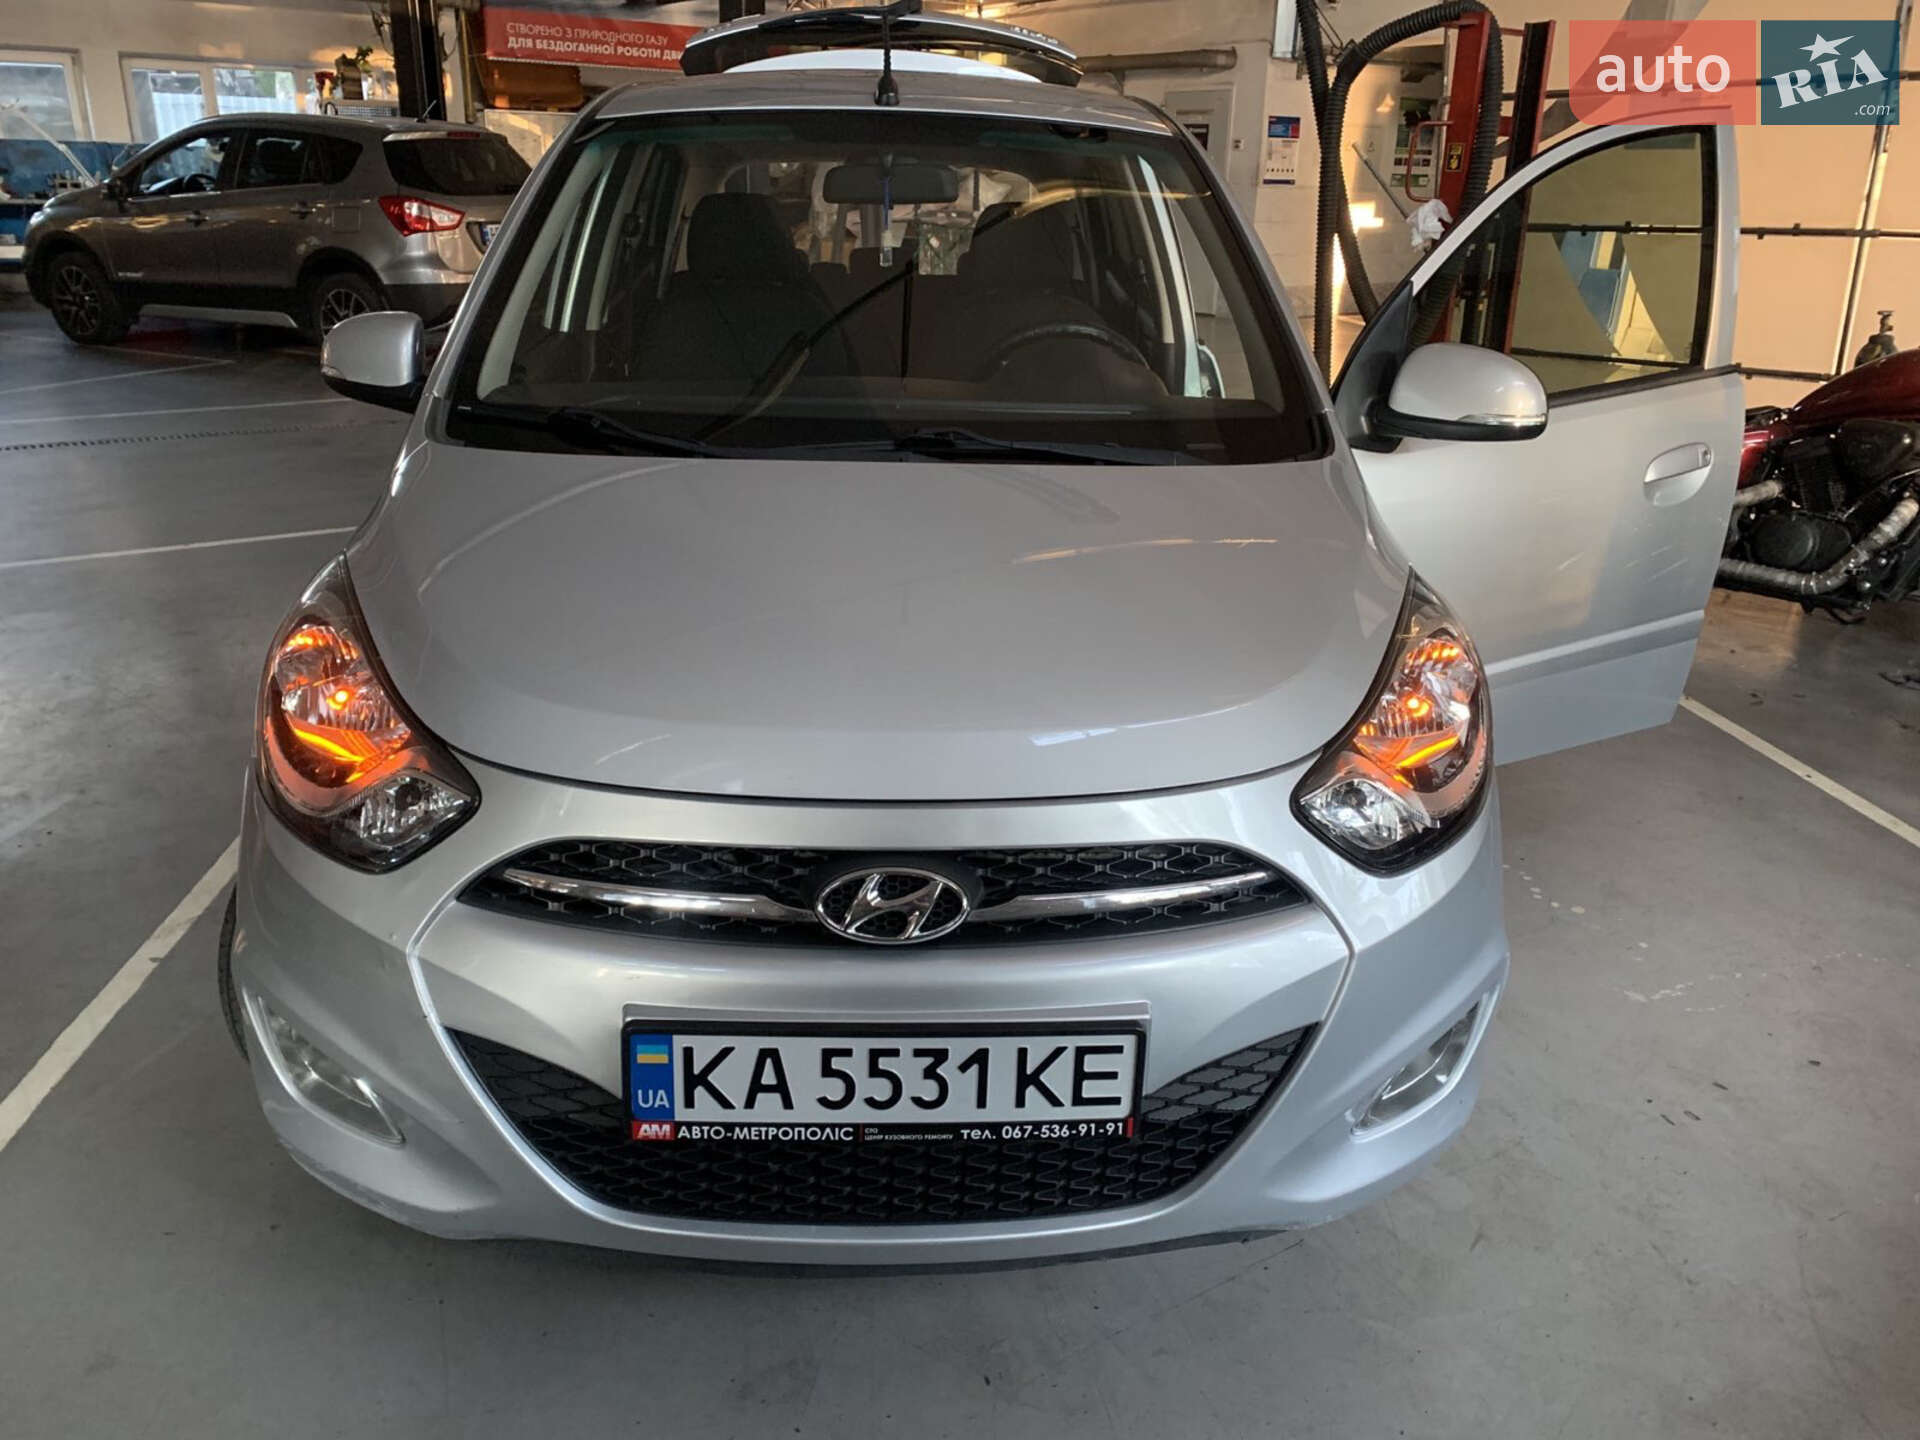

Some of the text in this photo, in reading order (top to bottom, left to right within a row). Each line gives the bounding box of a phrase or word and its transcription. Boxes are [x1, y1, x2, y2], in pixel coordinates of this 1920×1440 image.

[506, 22, 563, 37] СТВОРЕНО
[574, 28, 644, 44] ПРИРОДНОГО
[645, 34, 668, 46] ГАЗУ
[507, 36, 534, 49] ДЛЯ
[535, 38, 615, 55] БЕЗДОГАННОЇ
[617, 45, 661, 59] РОБОТИ
[682, 1045, 1124, 1111] KA 5531 KE
[637, 1089, 670, 1108] UA
[1001, 1122, 1124, 1139] 067-536-91-91
